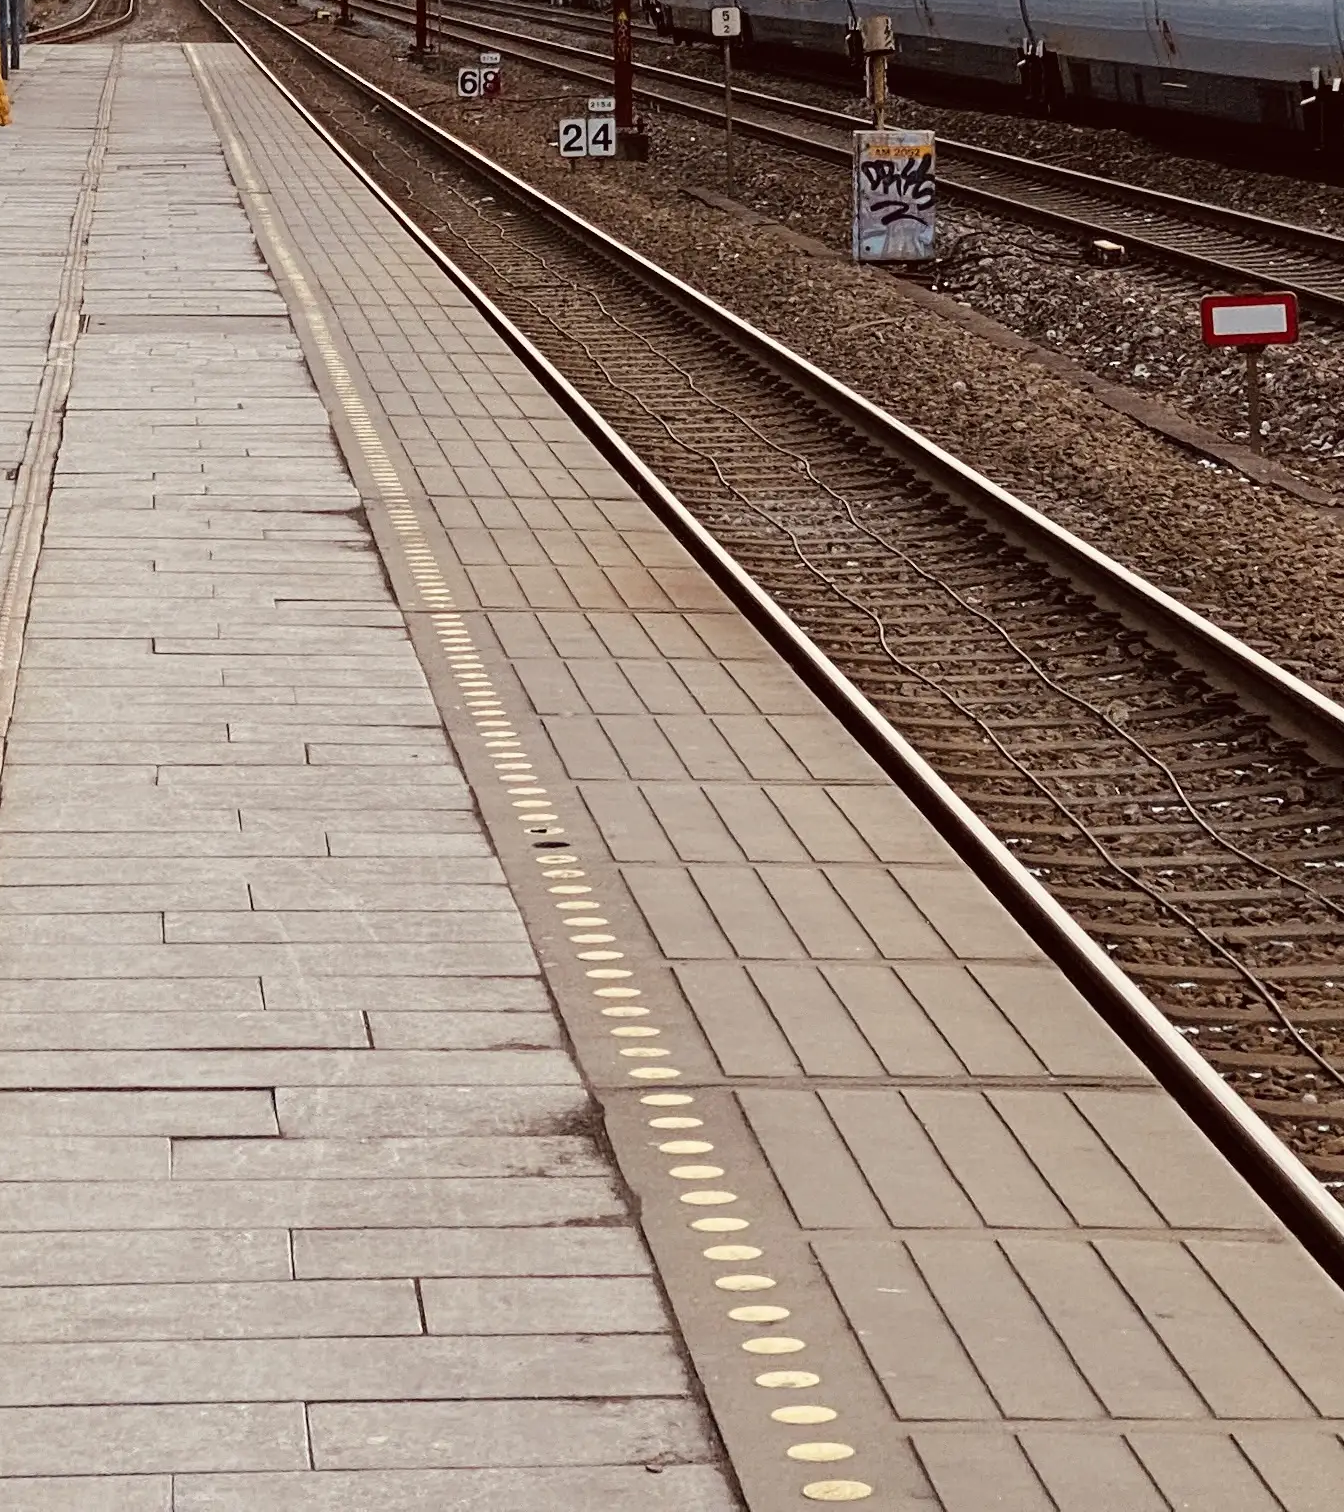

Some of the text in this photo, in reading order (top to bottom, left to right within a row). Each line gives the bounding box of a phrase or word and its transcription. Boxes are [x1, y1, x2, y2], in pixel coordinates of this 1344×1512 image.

[722, 10, 730, 22] 5
[723, 24, 730, 34] 2
[460, 70, 500, 95] 68
[562, 123, 613, 152] 24
